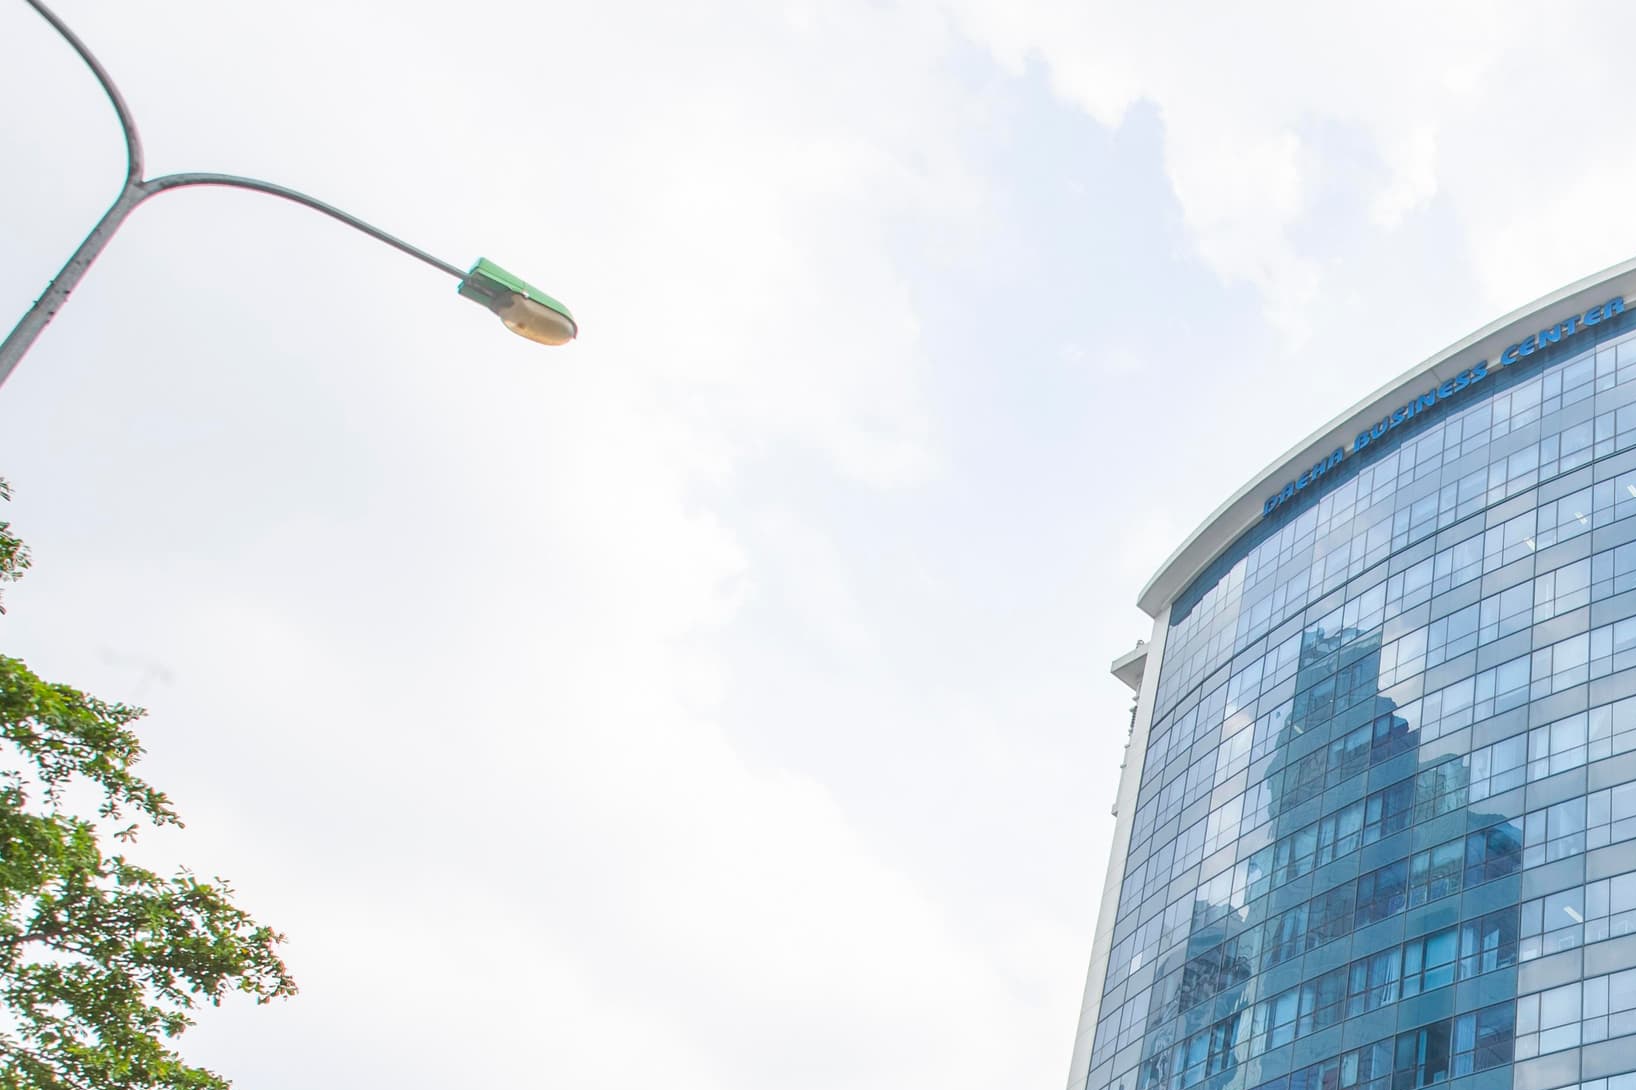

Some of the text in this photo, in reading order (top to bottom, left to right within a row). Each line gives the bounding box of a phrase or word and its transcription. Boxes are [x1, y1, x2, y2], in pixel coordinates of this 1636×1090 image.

[1263, 295, 1625, 517] DAEHA BUSINESS CENTER
